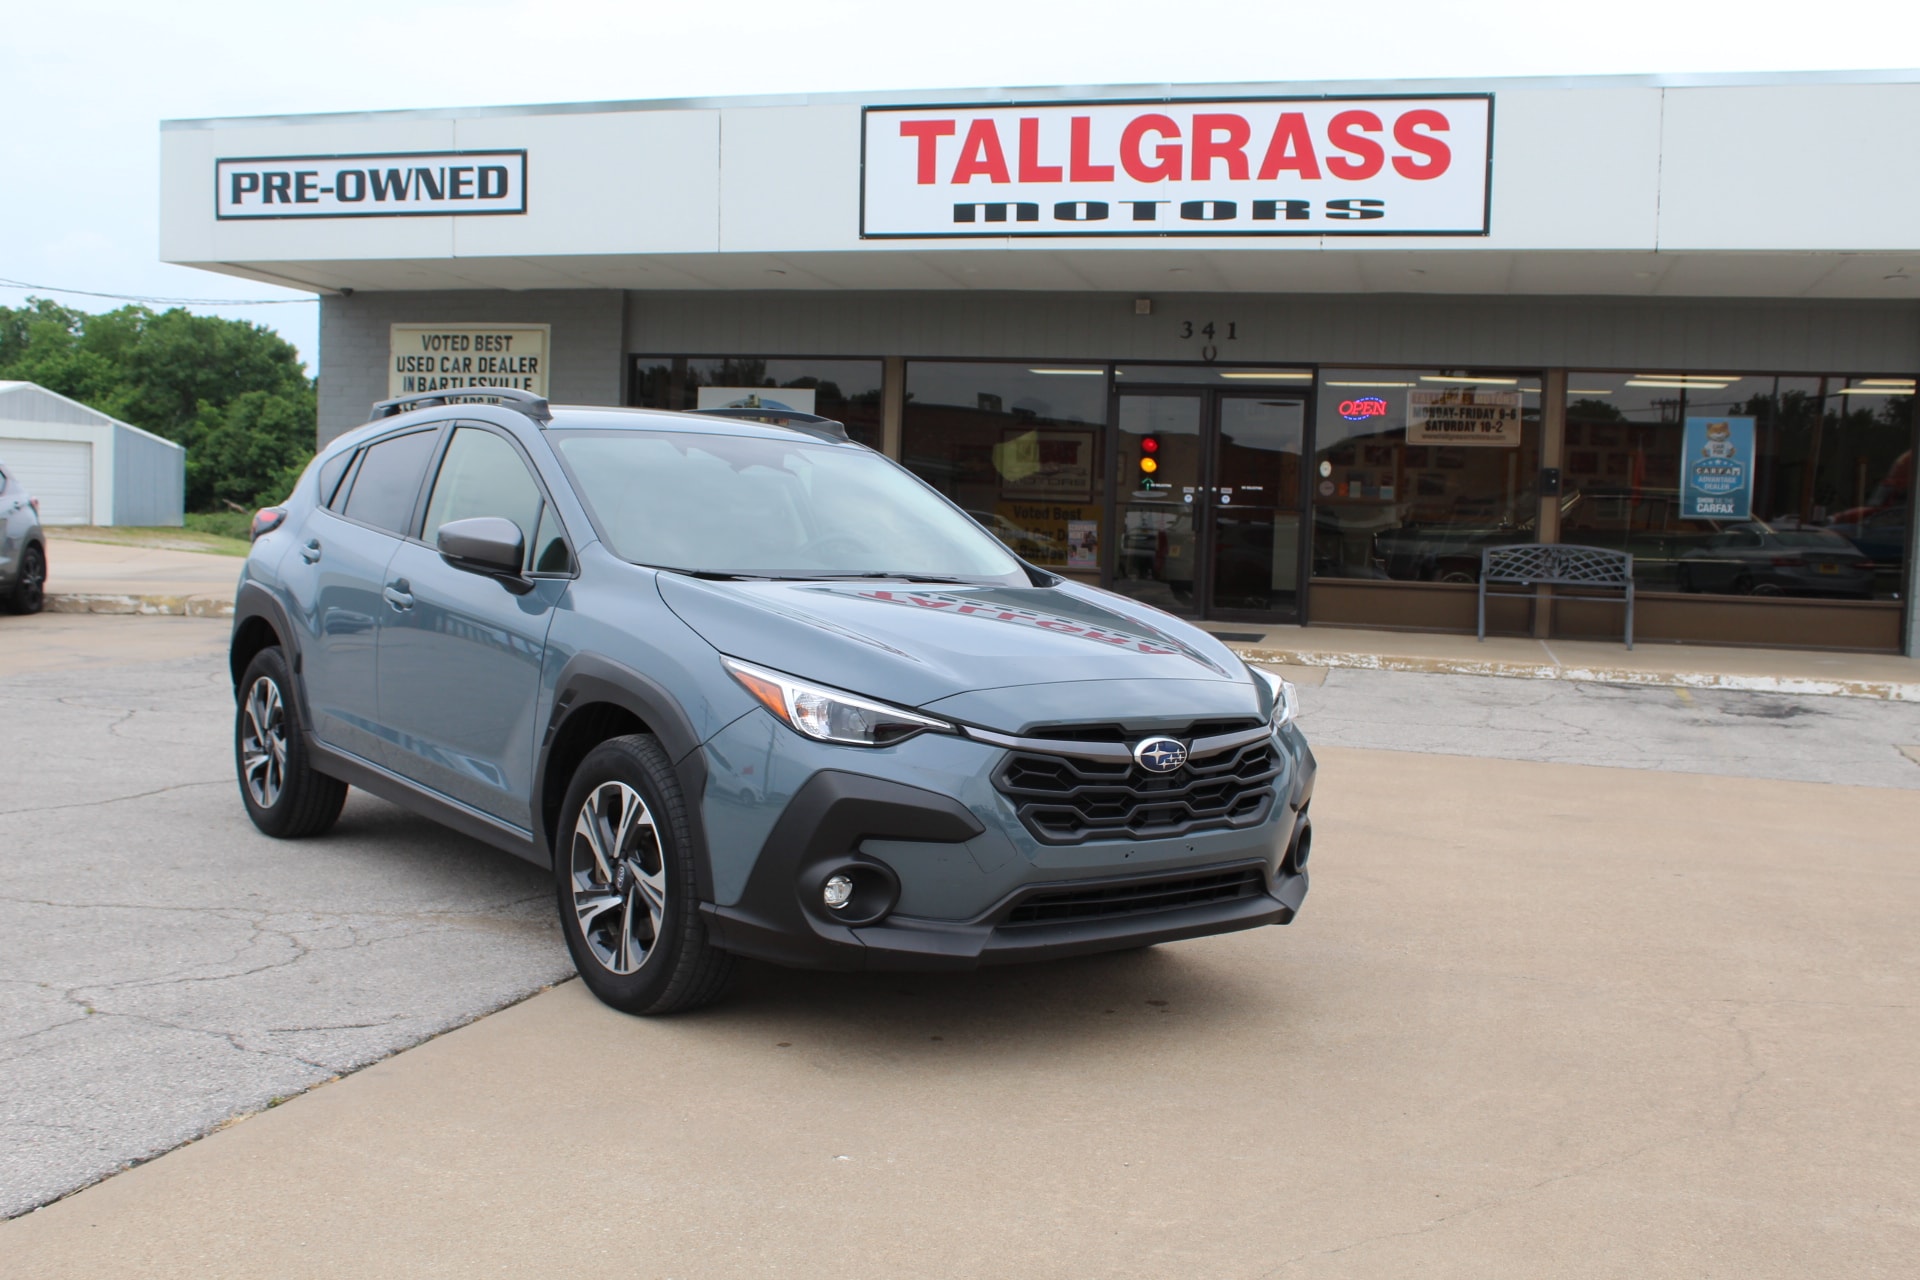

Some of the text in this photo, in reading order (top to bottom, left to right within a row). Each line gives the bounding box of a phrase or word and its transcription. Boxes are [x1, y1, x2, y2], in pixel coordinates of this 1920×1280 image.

[899, 108, 1452, 185] TALLGRASS
[231, 165, 508, 204] PRE-OWNED
[953, 199, 1385, 223] MOTORS
[422, 335, 513, 352] VOTED BEST
[397, 356, 538, 373] USED CAR DEALER
[403, 376, 415, 392] IN
[1338, 400, 1388, 416] OPEN
[1413, 406, 1495, 420] MONDAY-FRIDAY
[1425, 420, 1504, 433] SATURDAY 10-2
[1013, 505, 1082, 520] Voted Best
[1696, 503, 1734, 513] CARFAX
